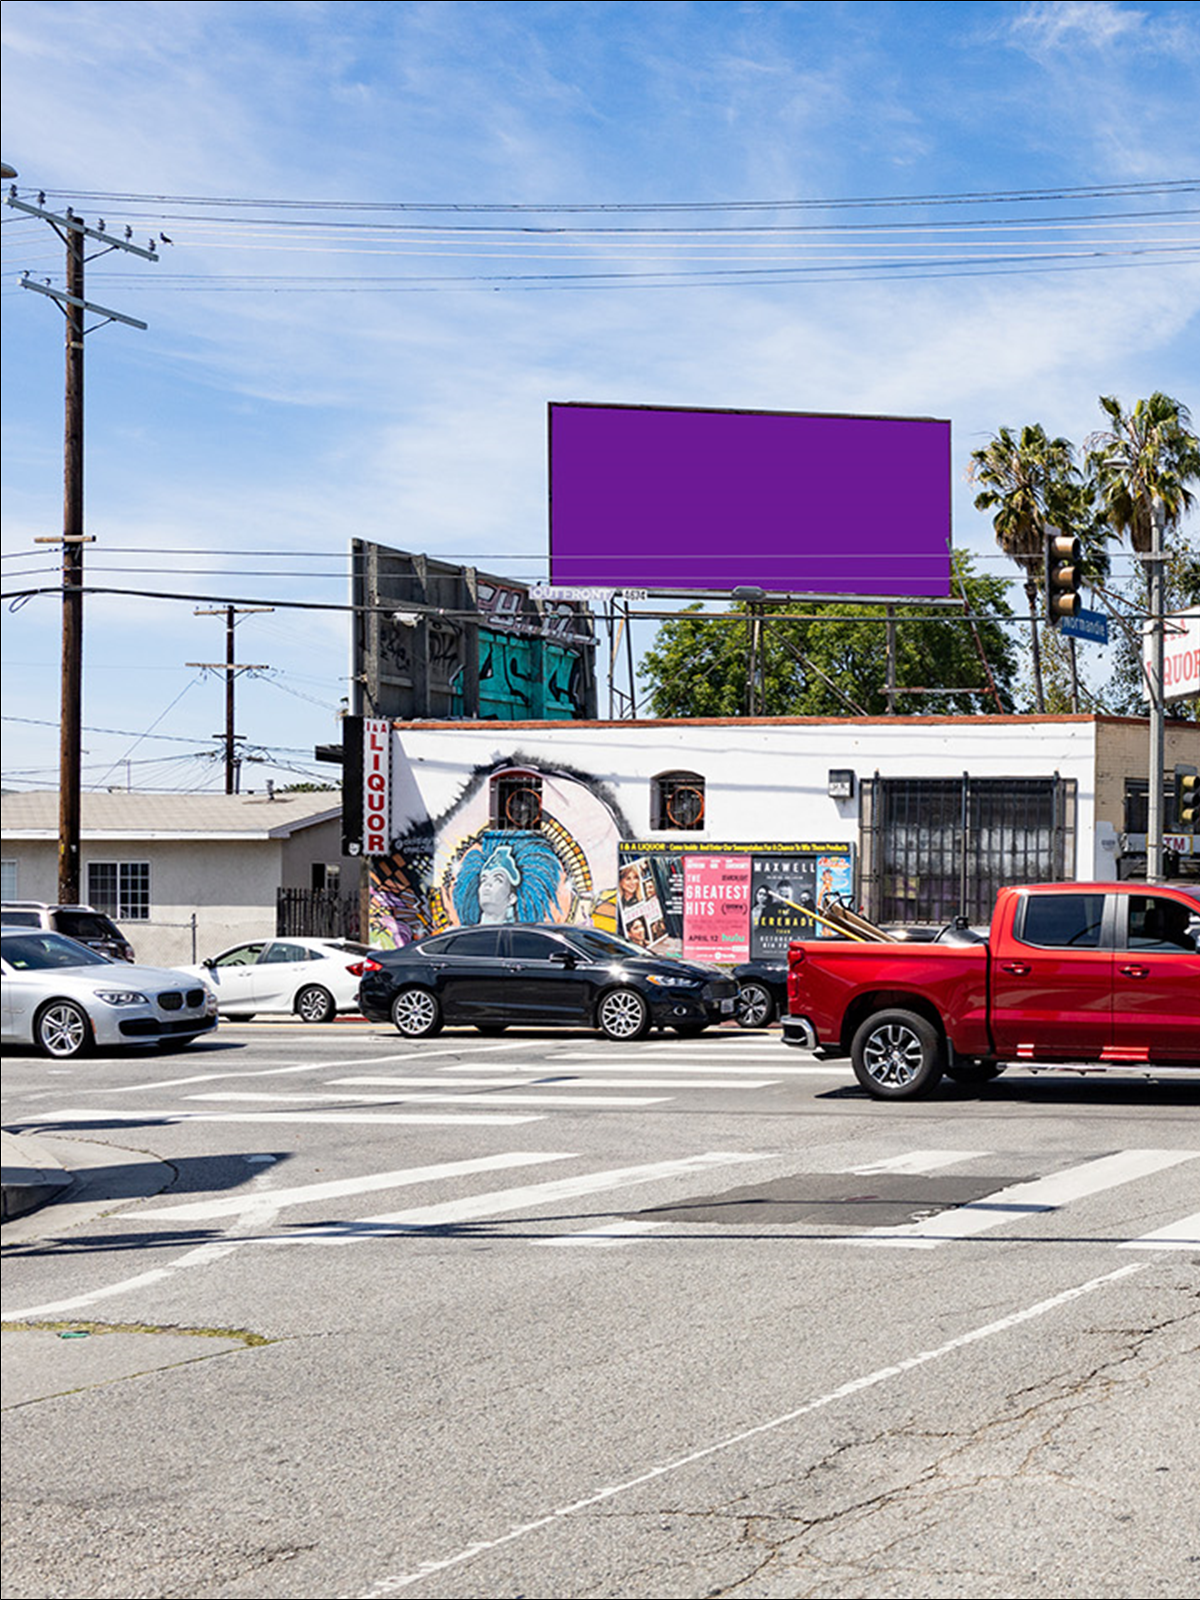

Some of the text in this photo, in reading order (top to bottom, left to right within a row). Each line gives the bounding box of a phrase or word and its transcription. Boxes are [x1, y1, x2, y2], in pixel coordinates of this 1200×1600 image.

[367, 733, 386, 852] LIQUOR
[637, 843, 666, 851] LIQUOR
[754, 862, 815, 873] MAXWELL
[687, 873, 701, 883] THE
[686, 885, 749, 900] GREATEST
[686, 902, 715, 916] HITS
[754, 917, 814, 927] SERENADE
[689, 934, 709, 942] APRIL
[721, 933, 745, 942] hulu
